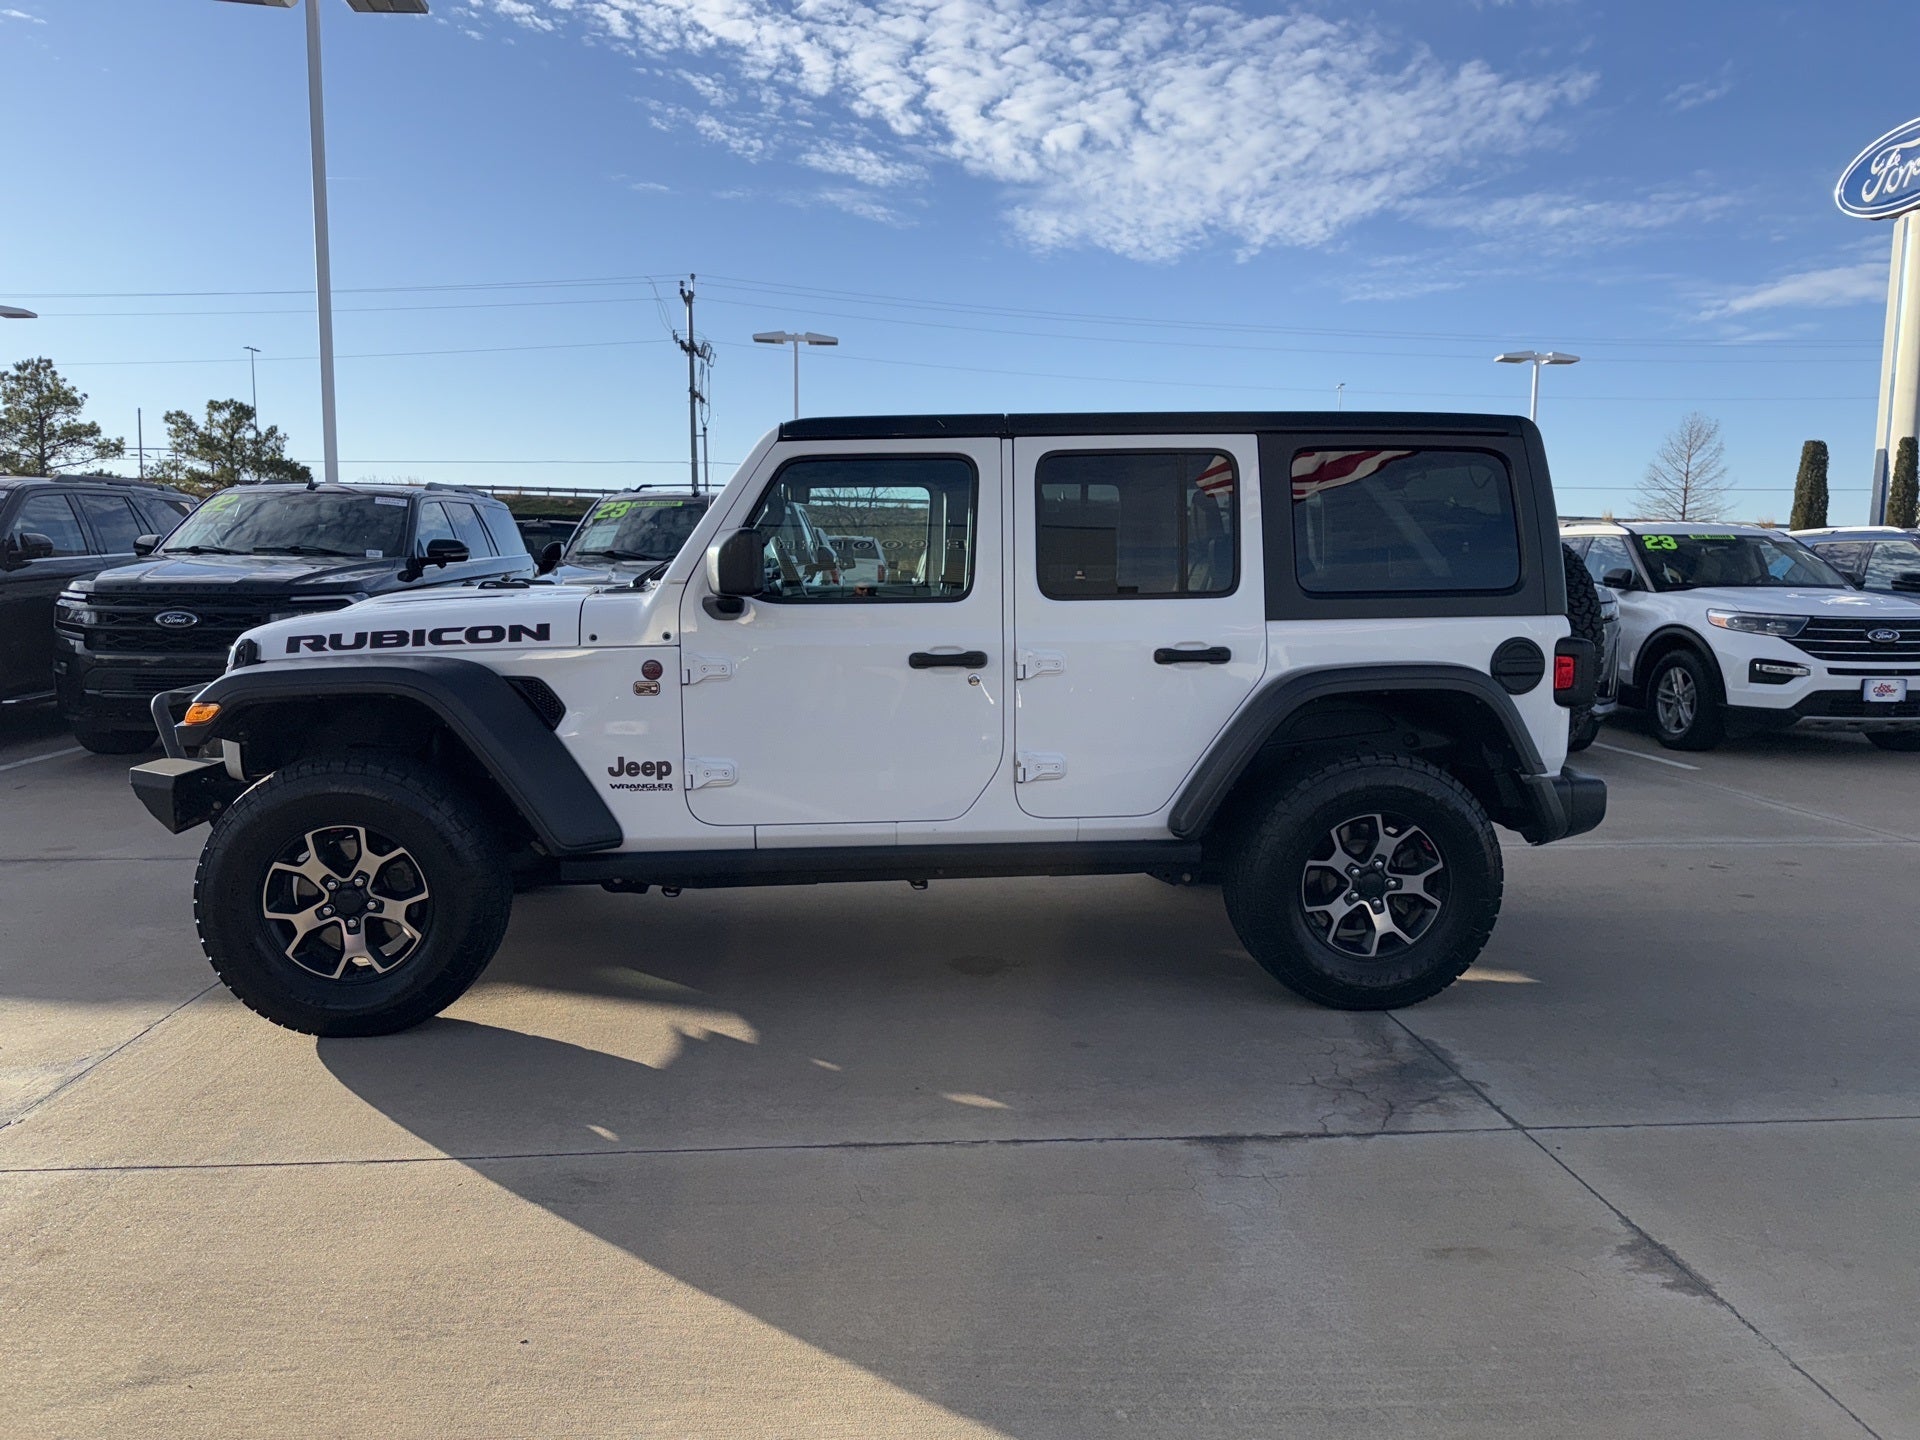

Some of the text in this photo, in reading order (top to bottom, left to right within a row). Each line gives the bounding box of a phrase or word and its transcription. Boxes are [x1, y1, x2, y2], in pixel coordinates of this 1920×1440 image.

[1861, 137, 1920, 203] For
[593, 501, 632, 519] 23
[1642, 534, 1678, 550] 23
[164, 614, 187, 624] Ford
[285, 623, 550, 654] RUBICON
[607, 756, 672, 780] Jeep
